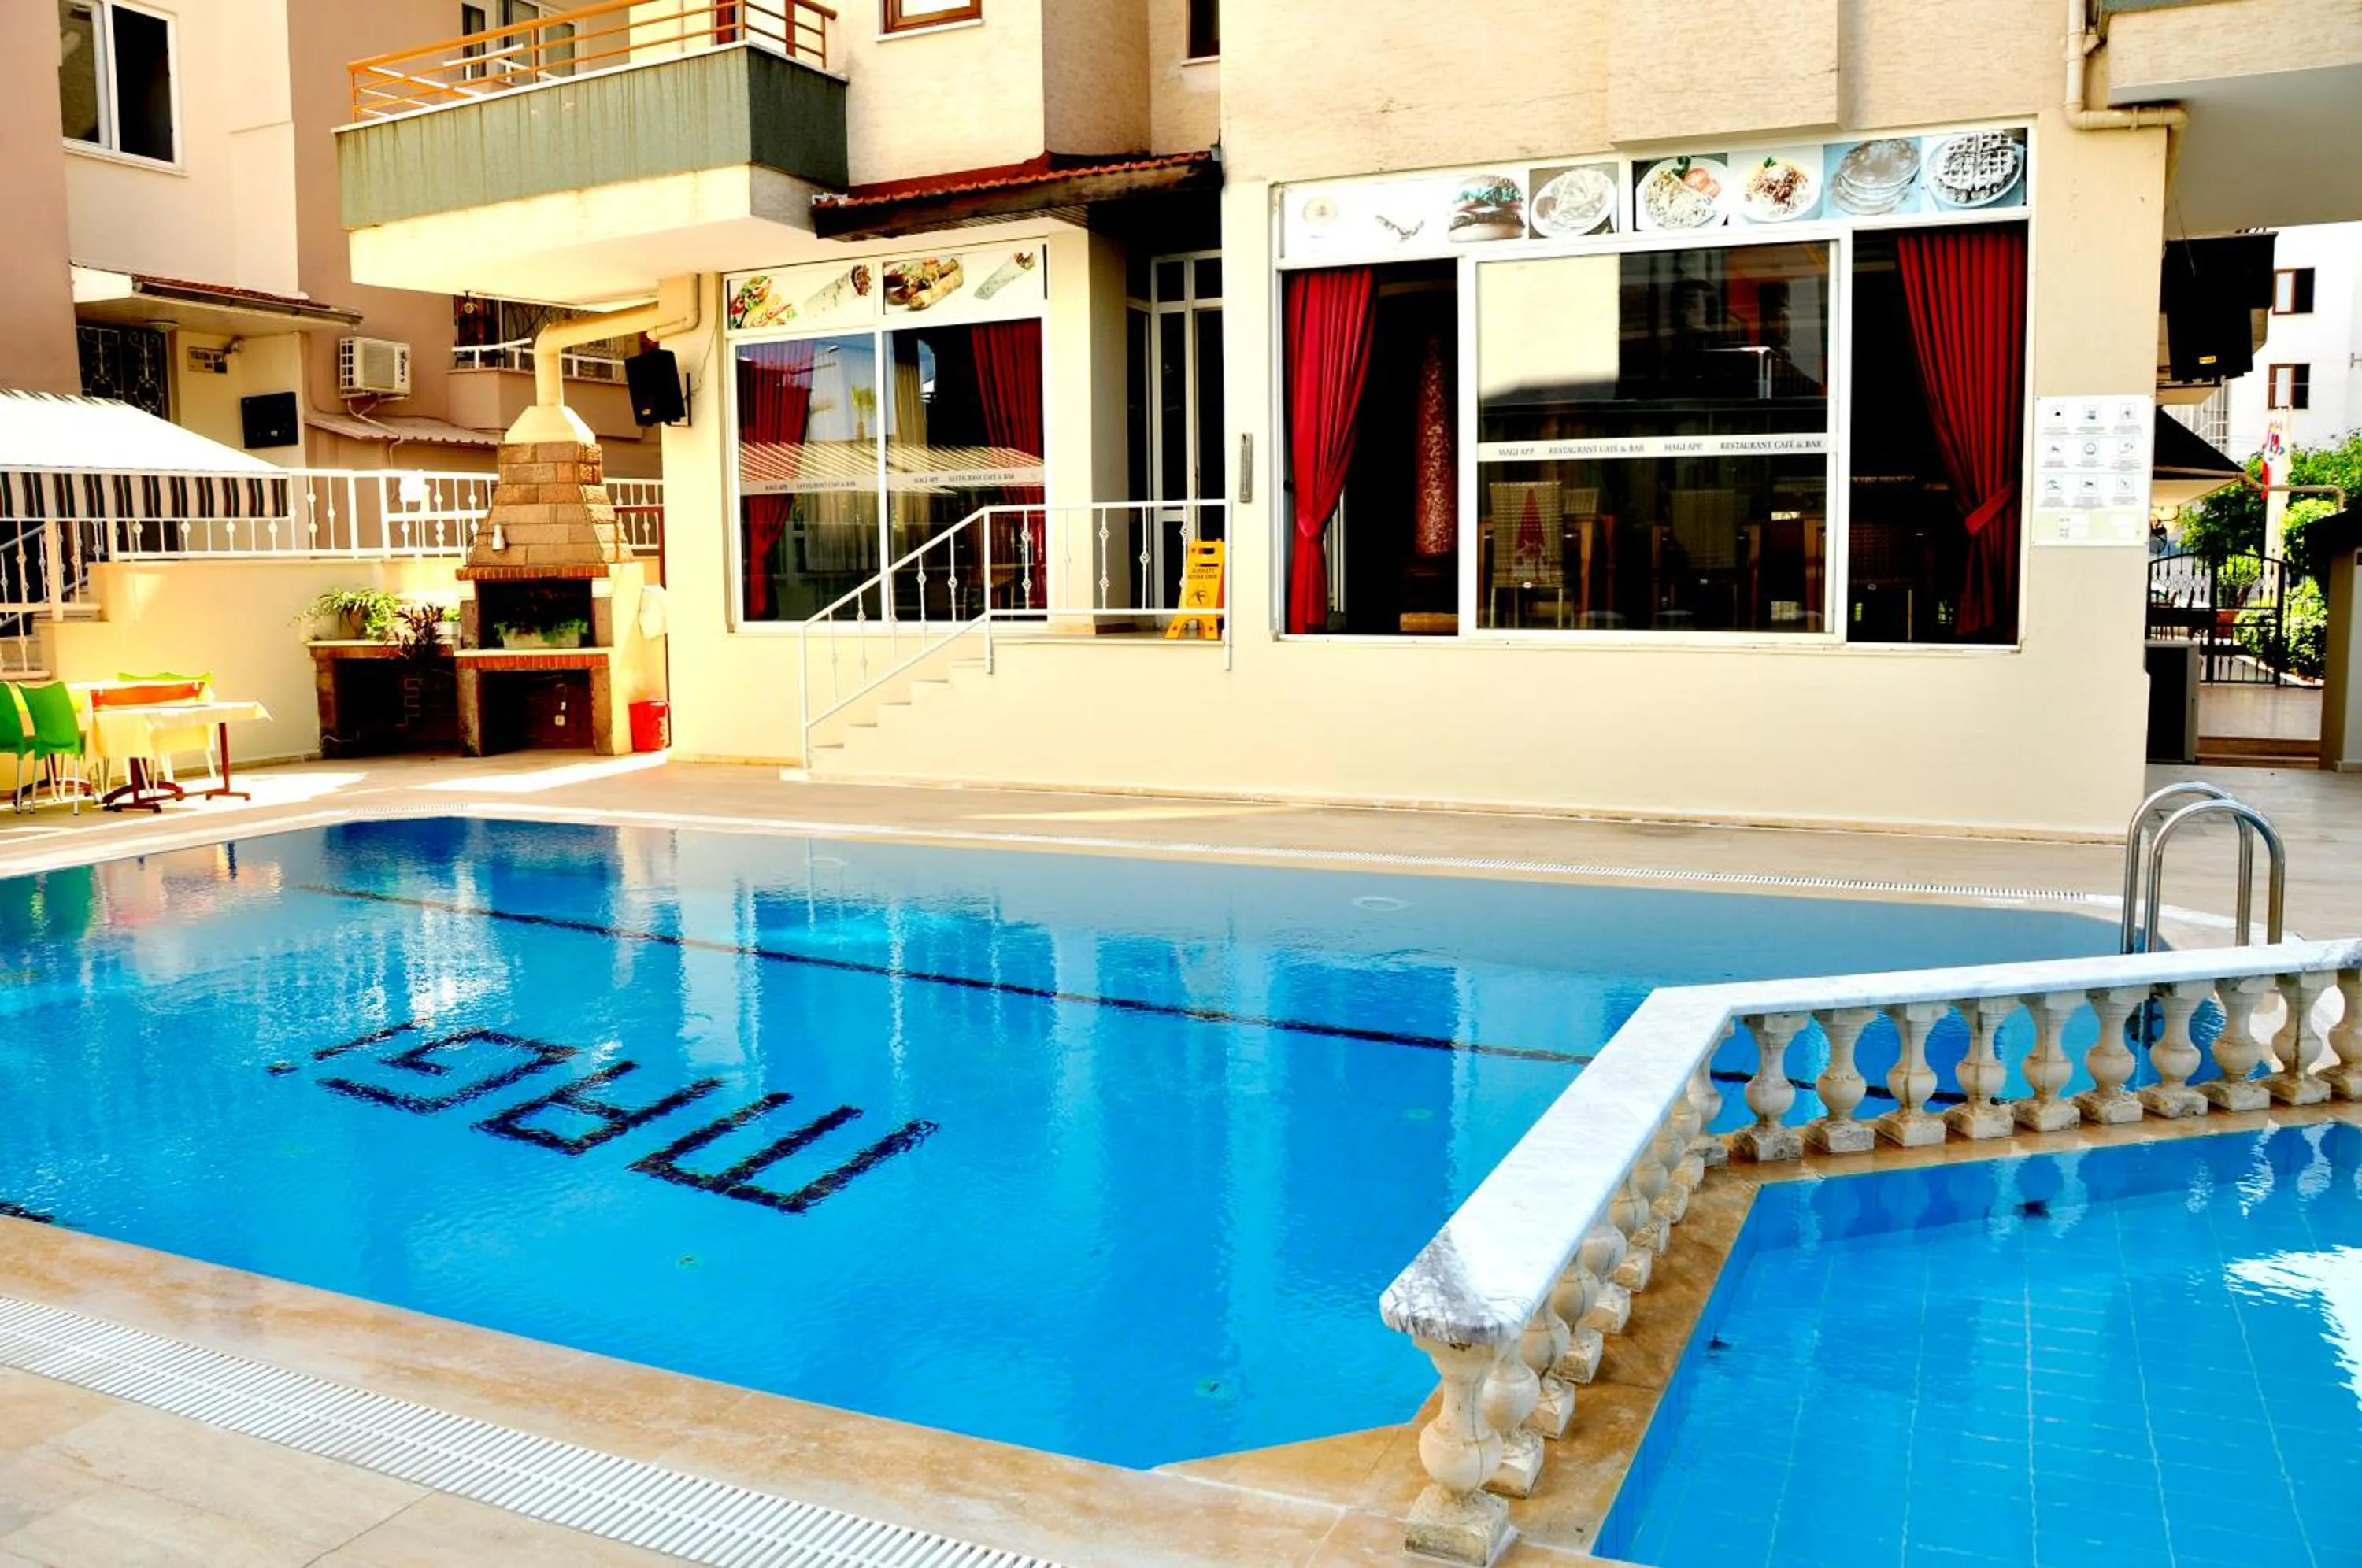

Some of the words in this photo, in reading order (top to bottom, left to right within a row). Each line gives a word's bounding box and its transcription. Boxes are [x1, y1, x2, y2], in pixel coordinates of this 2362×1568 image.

[1549, 445, 1598, 454] RESTAURANT
[1629, 443, 1645, 453] BAR
[1720, 441, 1772, 450] RESTAURANT
[1805, 439, 1823, 449] BAR
